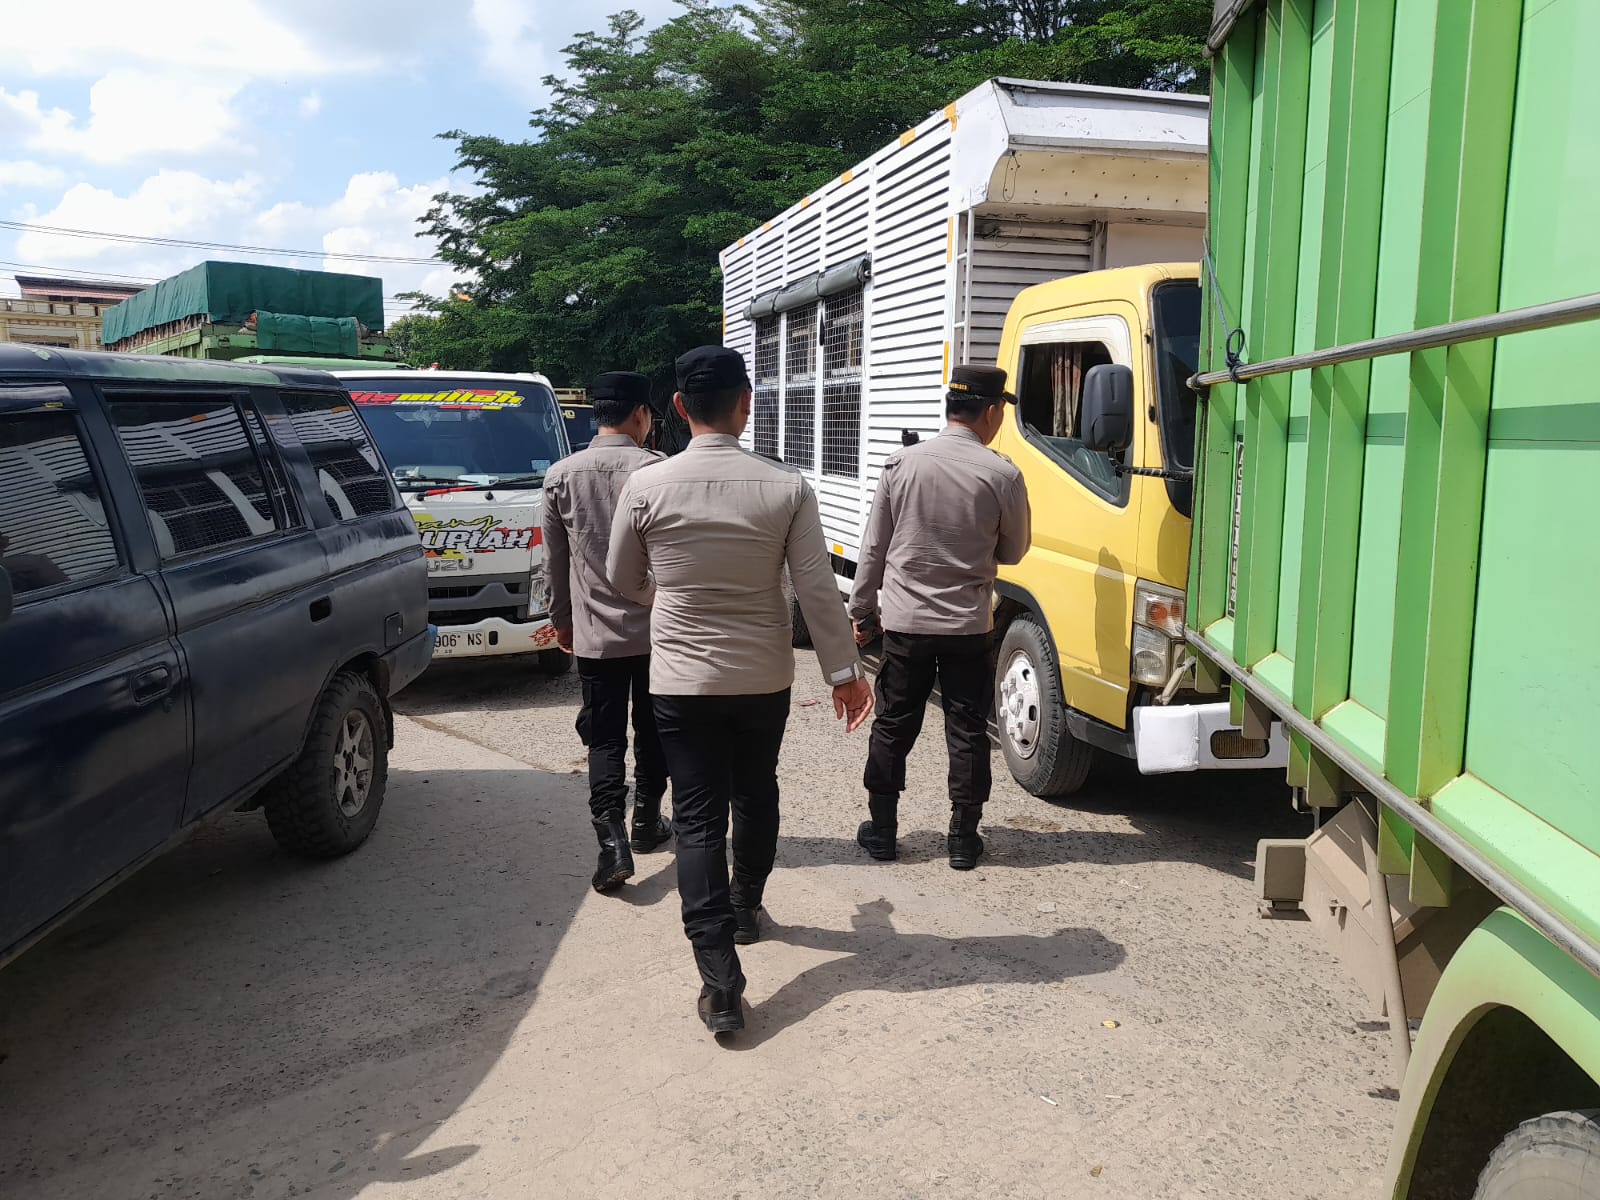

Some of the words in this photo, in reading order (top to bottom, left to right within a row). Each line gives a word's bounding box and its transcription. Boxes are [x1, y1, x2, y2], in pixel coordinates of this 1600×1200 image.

[420, 530, 533, 549] UPIAH
[427, 558, 473, 572] UZU
[467, 633, 482, 646] NS
